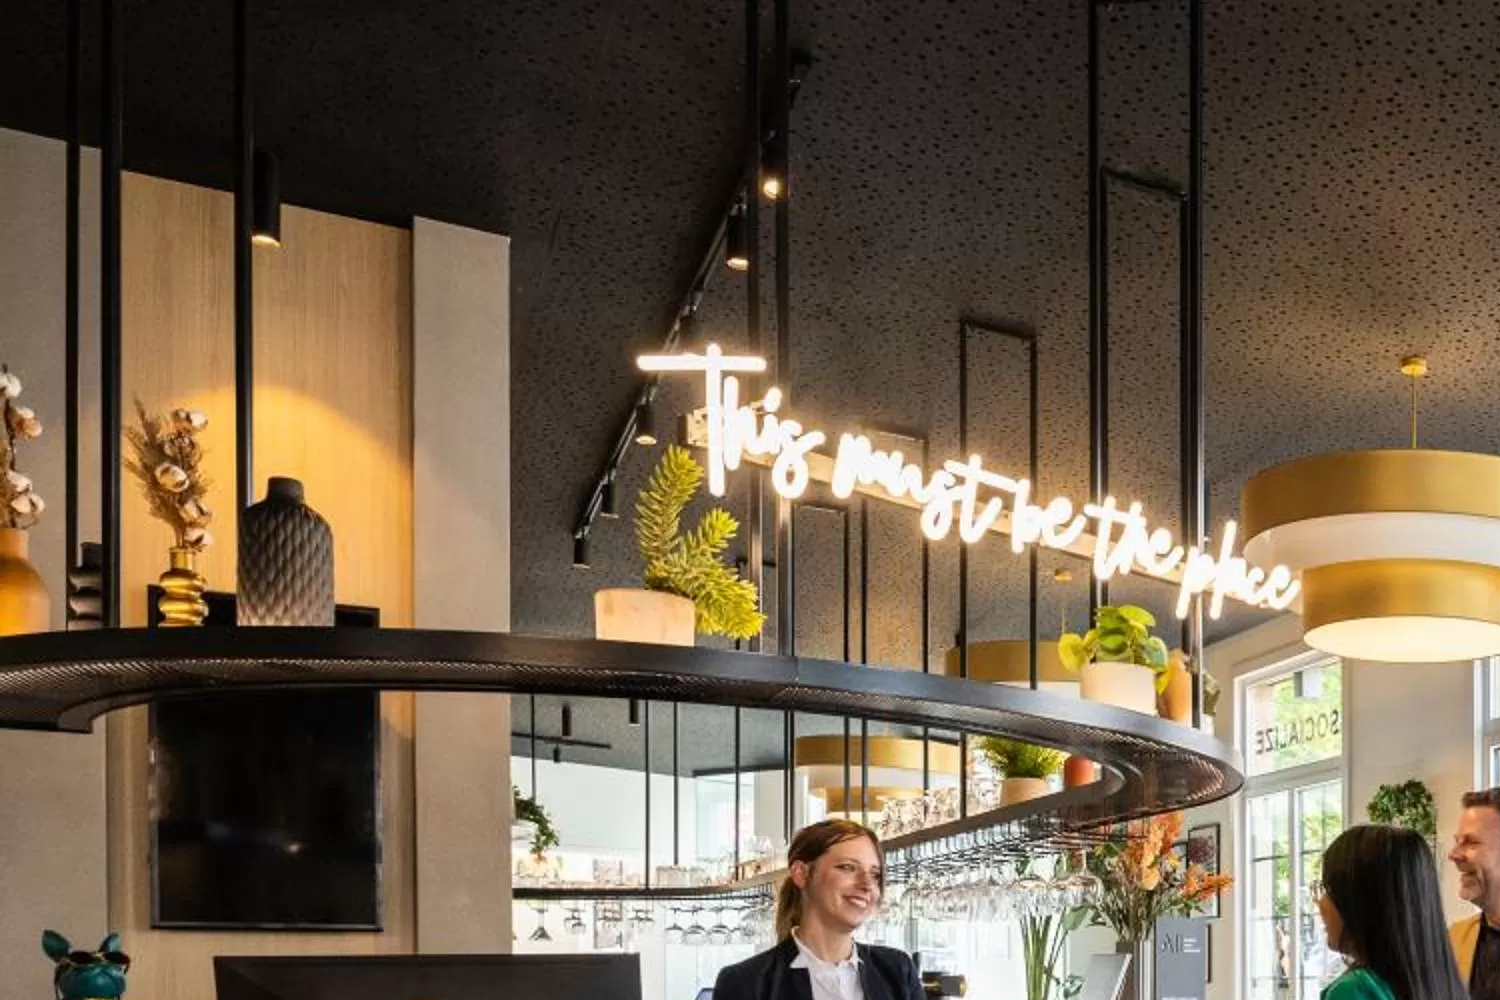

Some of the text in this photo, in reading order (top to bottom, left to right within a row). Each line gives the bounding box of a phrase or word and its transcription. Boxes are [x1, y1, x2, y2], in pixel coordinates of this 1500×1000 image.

[637, 344, 1301, 618] This must be the place
